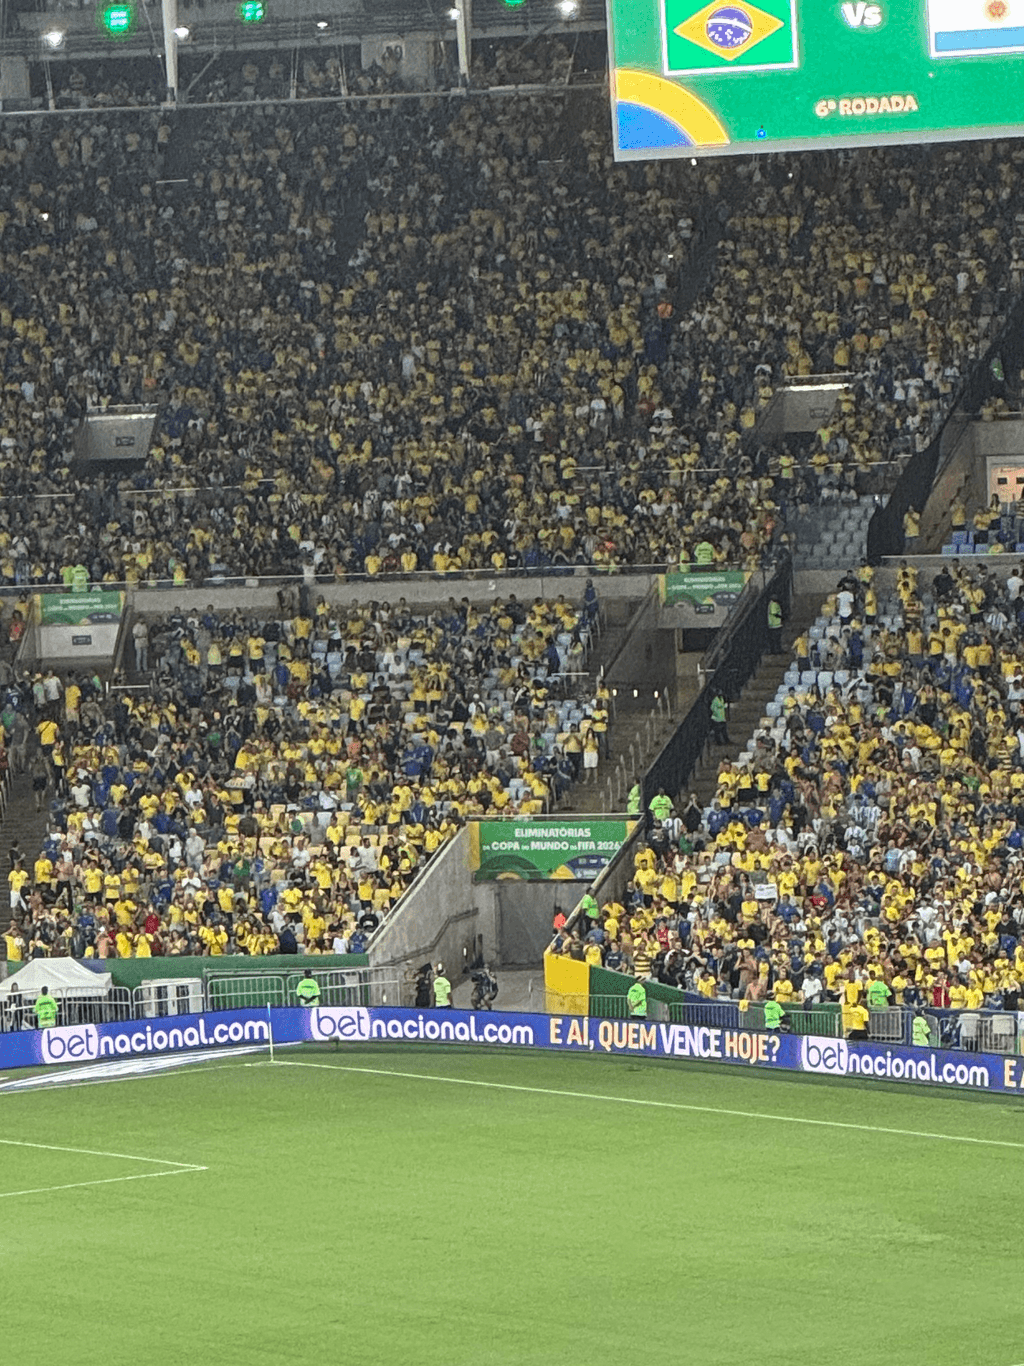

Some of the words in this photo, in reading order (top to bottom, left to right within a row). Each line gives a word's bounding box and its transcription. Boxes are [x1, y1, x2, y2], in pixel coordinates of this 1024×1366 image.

[841, 1, 882, 27] Vs
[839, 95, 918, 116] RODADA
[514, 826, 591, 838] ELIMINATÓRIAS
[491, 841, 520, 850] COPA
[530, 841, 569, 850] MUNDO
[578, 841, 596, 850] FIFA
[549, 1018, 563, 1045] E
[598, 1020, 656, 1051] QUEM
[659, 1023, 722, 1058] VENCE
[725, 1031, 781, 1064] HOJE?
[1004, 1059, 1017, 1087] E
